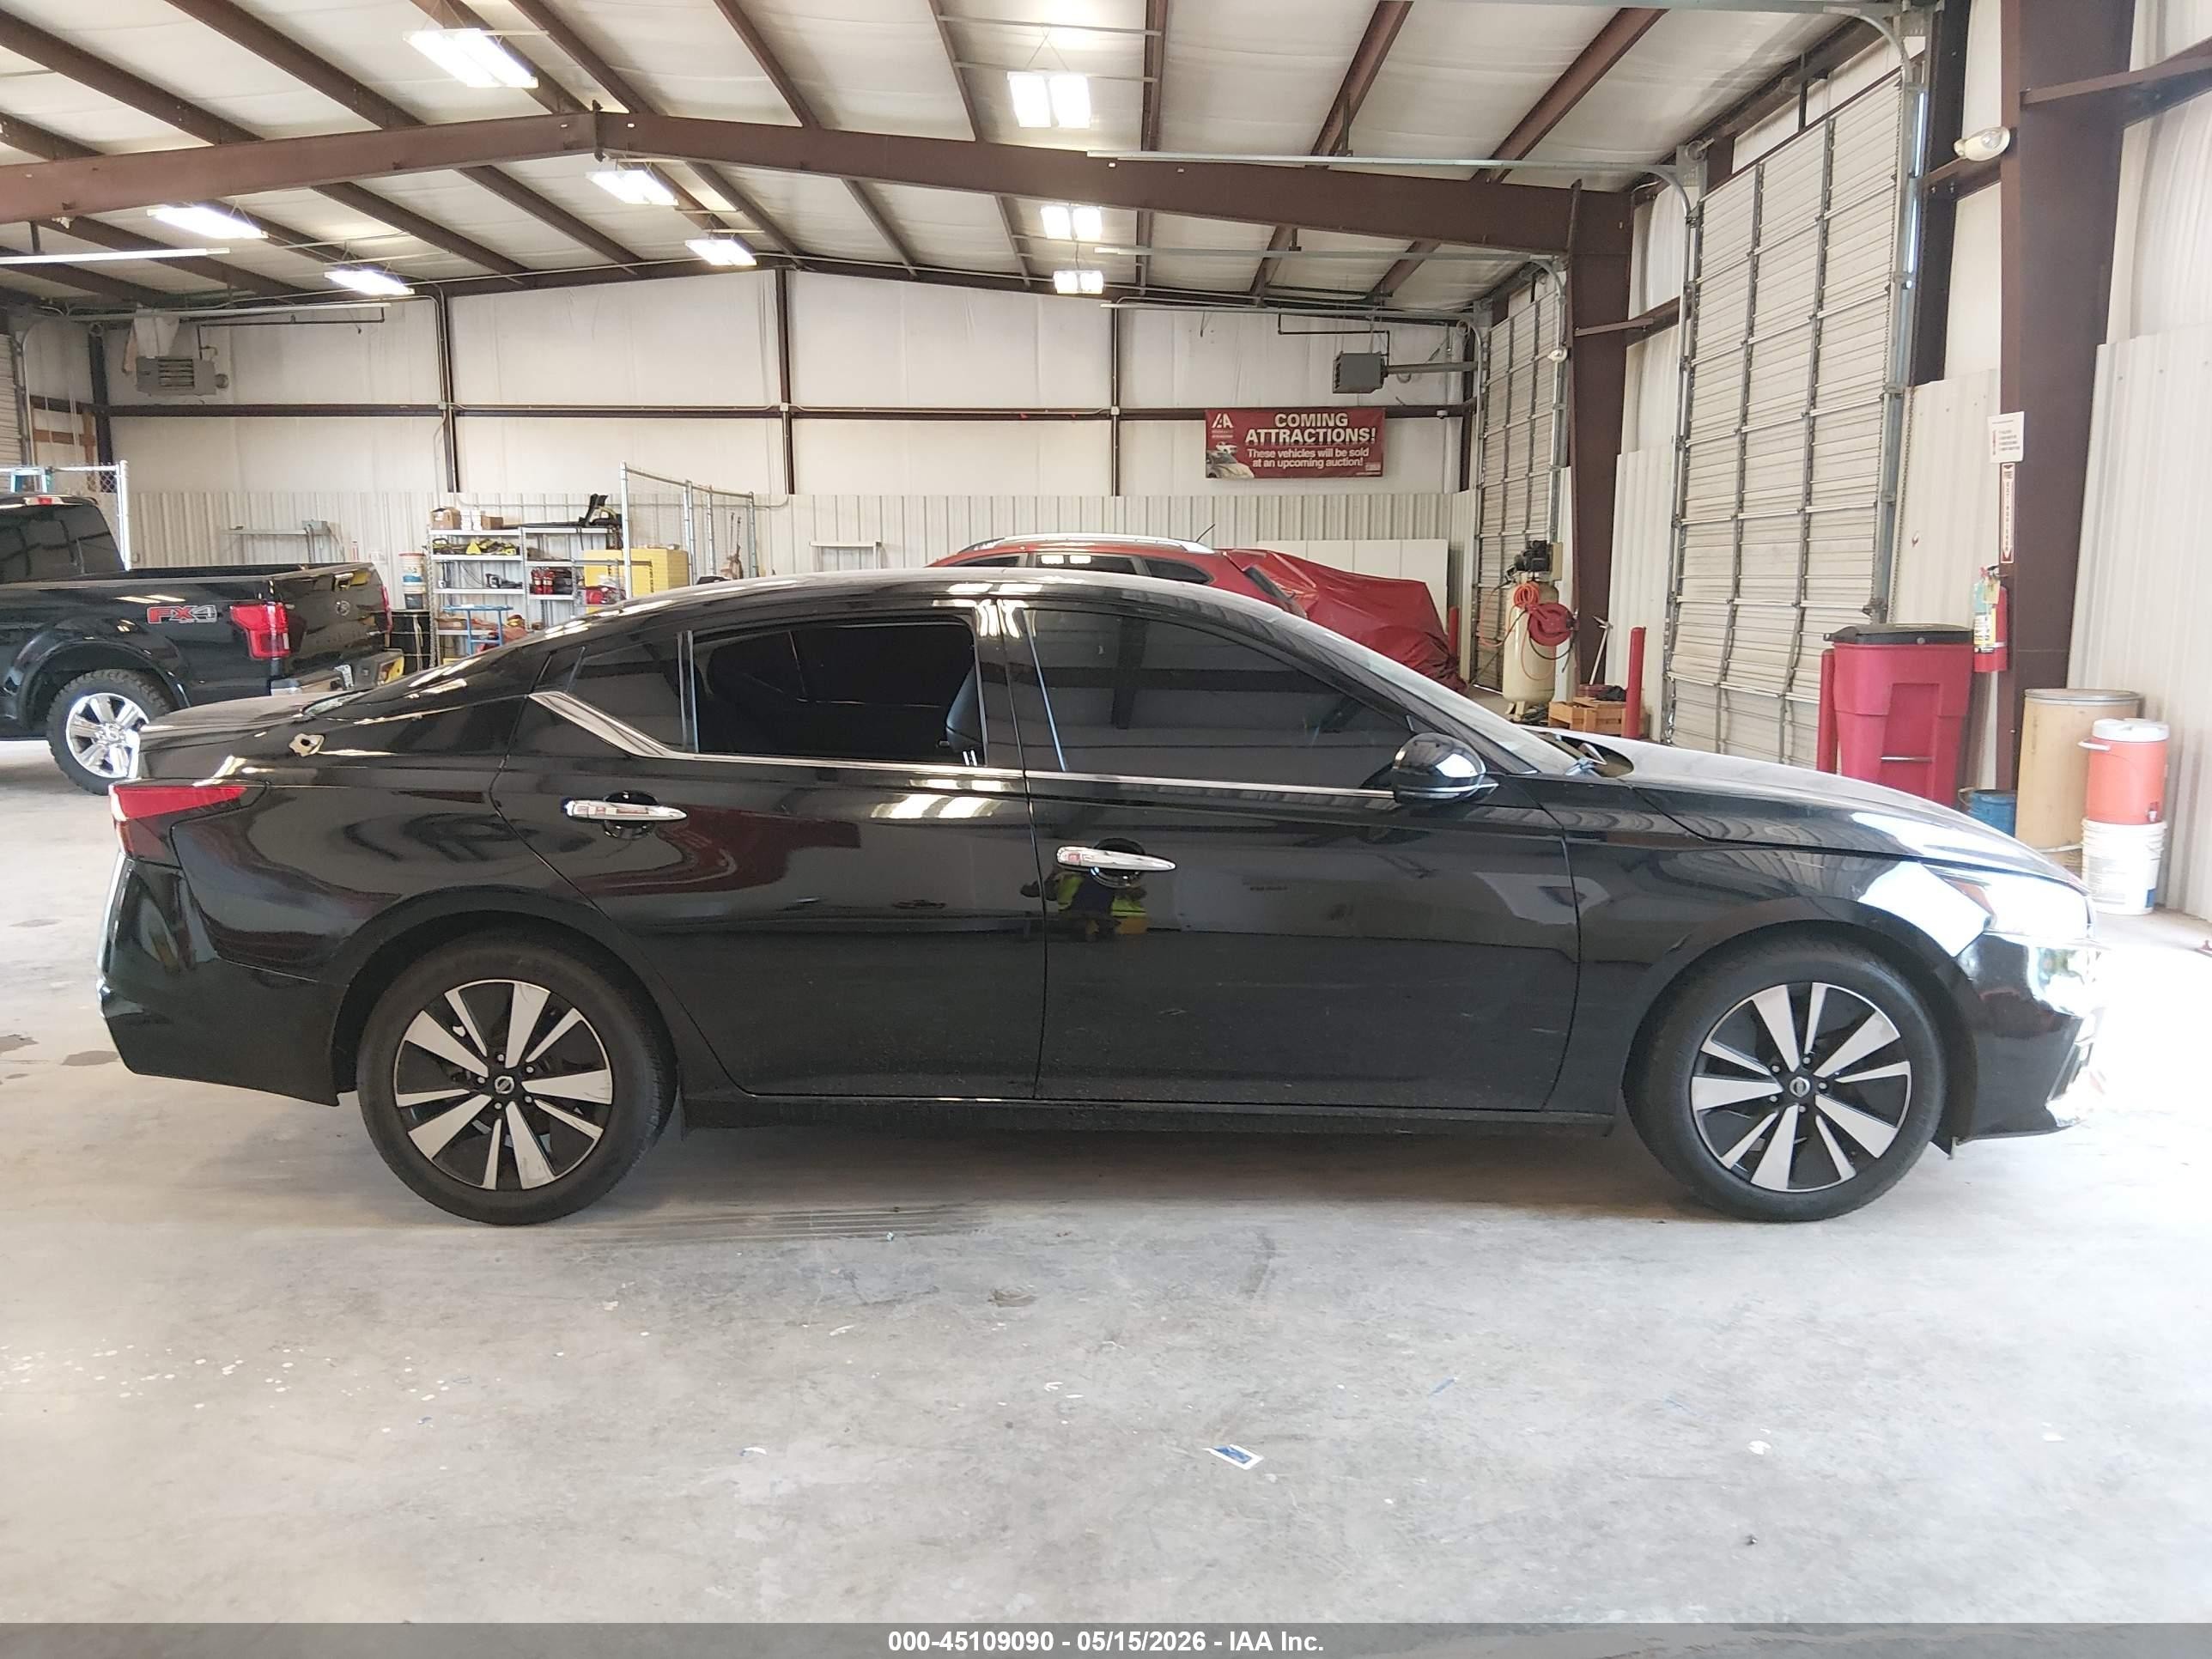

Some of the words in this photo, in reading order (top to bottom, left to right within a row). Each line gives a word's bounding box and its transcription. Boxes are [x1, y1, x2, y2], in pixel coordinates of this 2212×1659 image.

[1274, 413, 1348, 428] COMING
[1245, 428, 1376, 443] ATTRACTIONS!
[1247, 448, 1276, 459] These
[1277, 448, 1316, 458] vehicles
[1317, 447, 1334, 458] will
[1334, 447, 1348, 458] be
[1349, 447, 1370, 457] sold
[1252, 458, 1262, 468] at
[1263, 459, 1276, 468] an
[1277, 458, 1324, 470] upcoming
[1325, 457, 1364, 467] auction!
[147, 605, 217, 624] FX4
